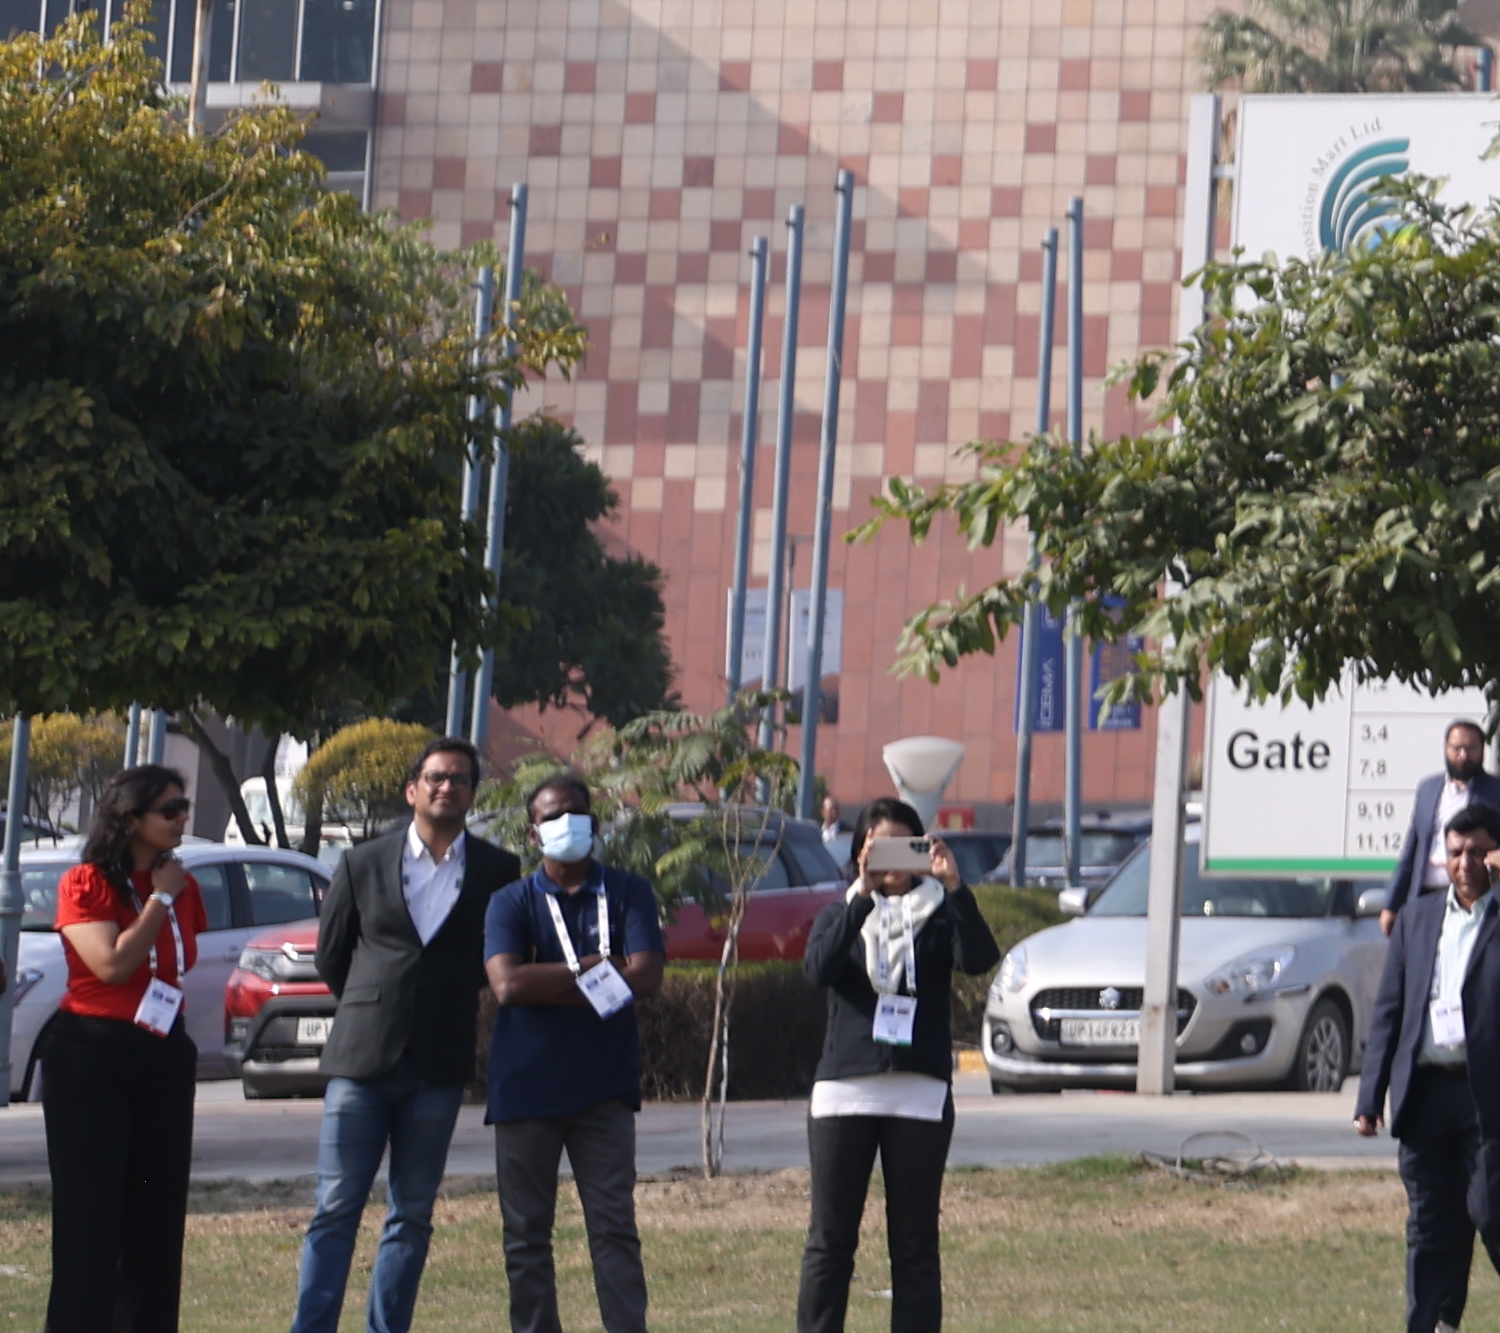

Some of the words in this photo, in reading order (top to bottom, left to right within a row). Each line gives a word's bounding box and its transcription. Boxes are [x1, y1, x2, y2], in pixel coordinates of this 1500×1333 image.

[1226, 728, 1331, 770] Gate
[1361, 724, 1388, 744] 3,4
[1360, 759, 1387, 779] 7,8
[1357, 802, 1394, 820] 9,10
[1356, 833, 1402, 852] 11,12
